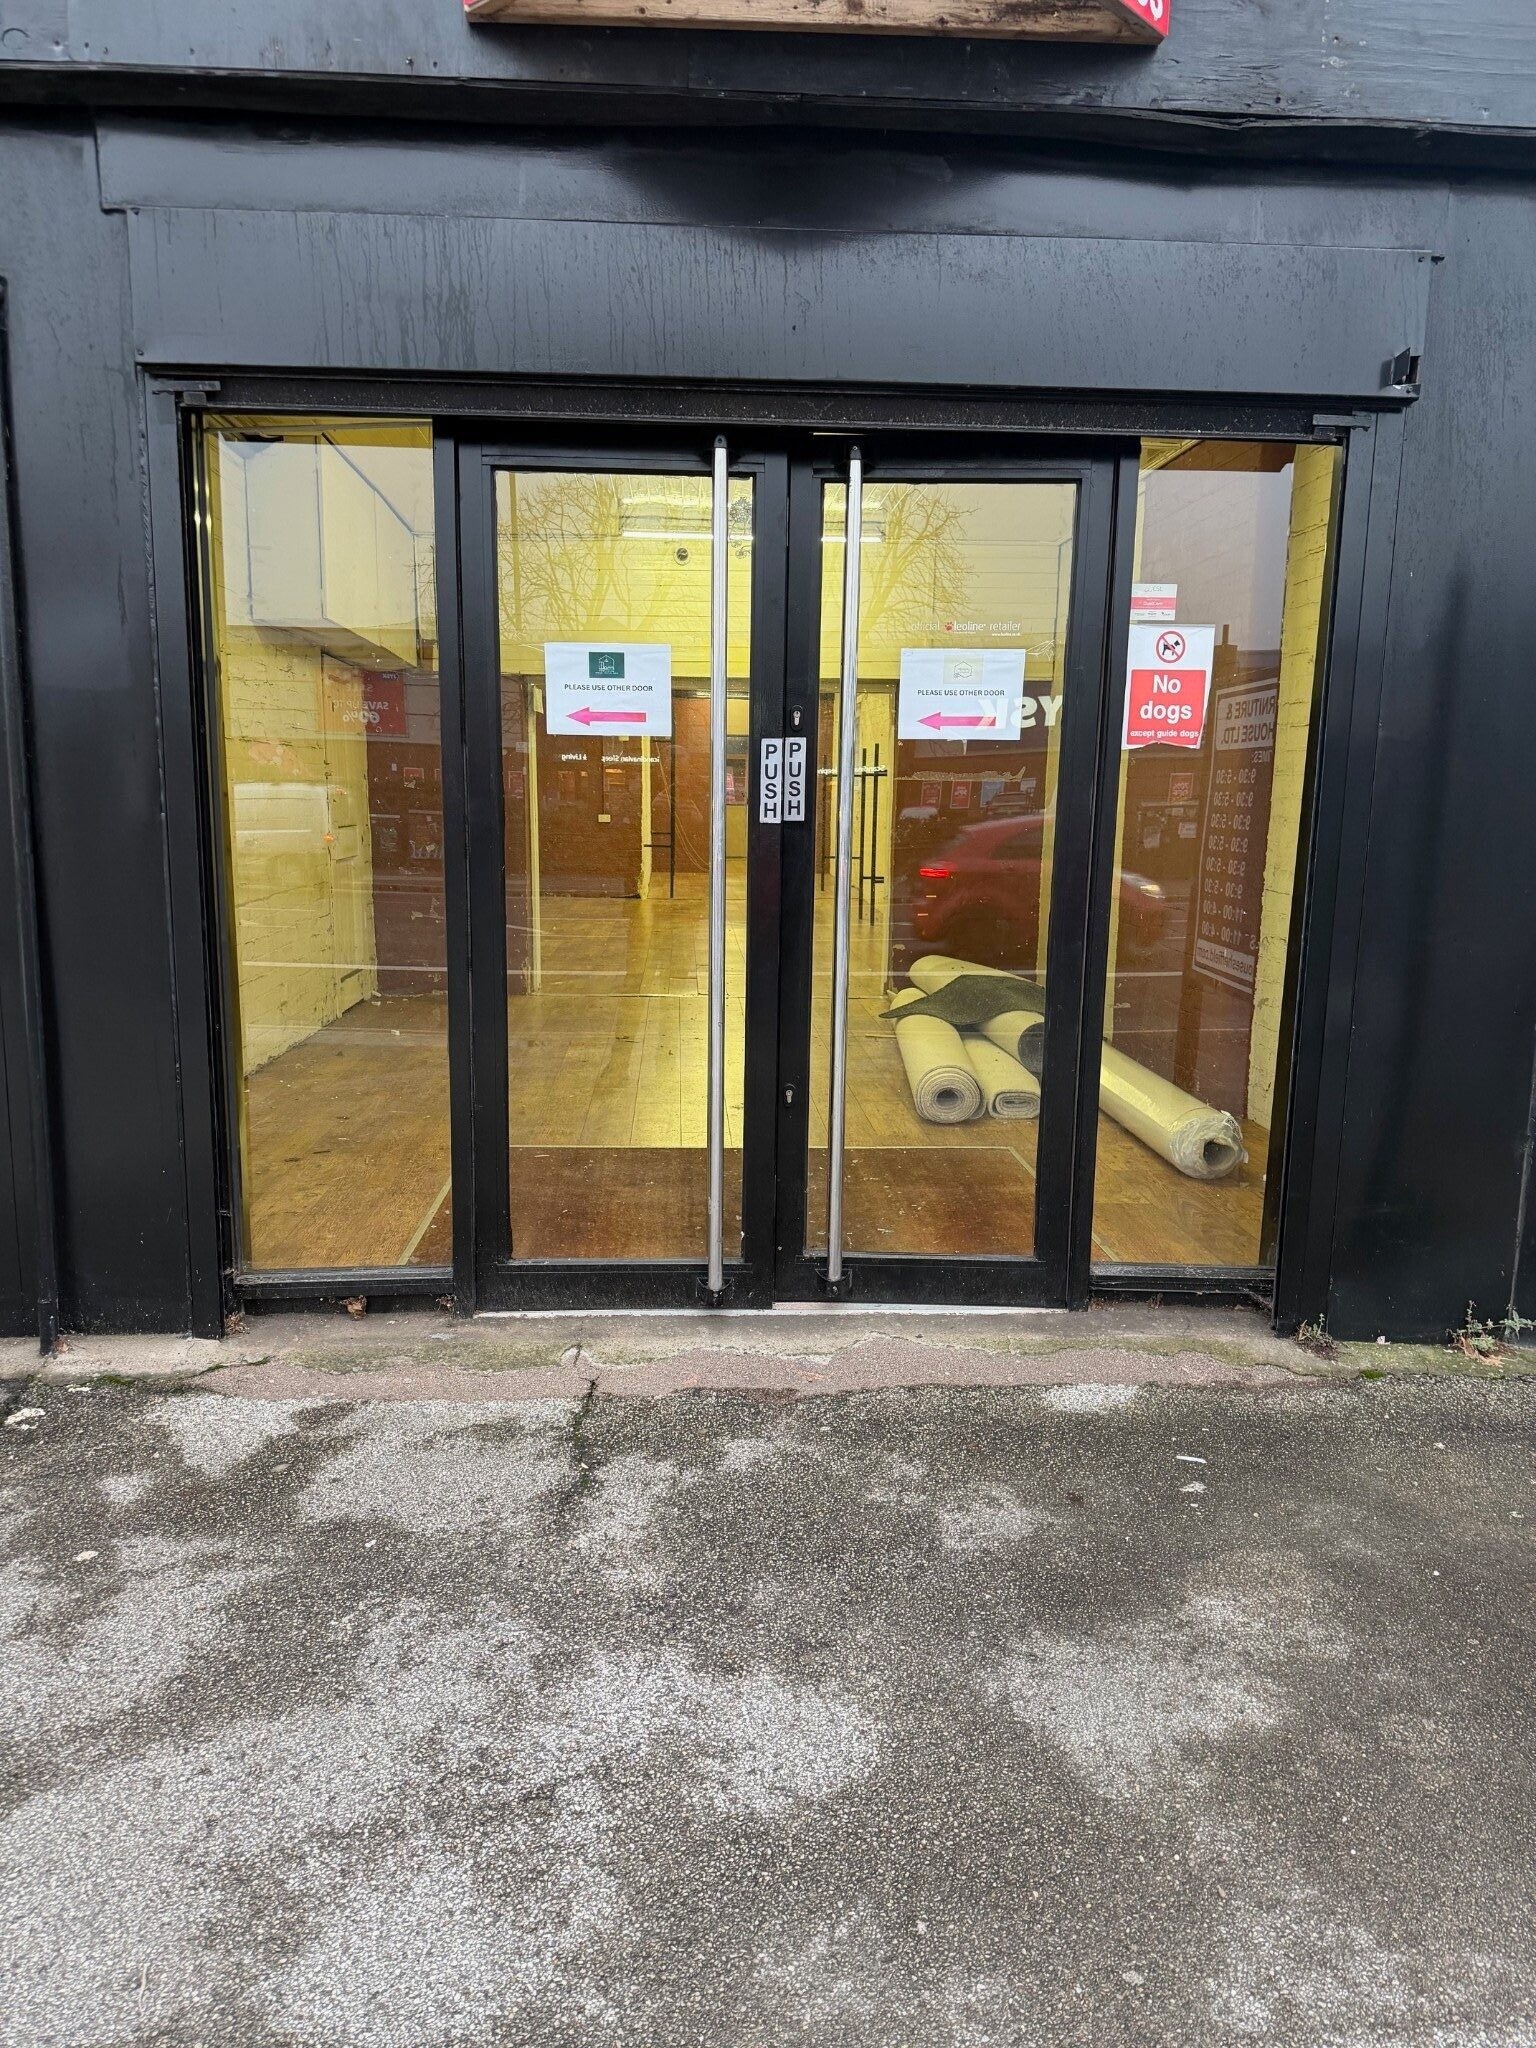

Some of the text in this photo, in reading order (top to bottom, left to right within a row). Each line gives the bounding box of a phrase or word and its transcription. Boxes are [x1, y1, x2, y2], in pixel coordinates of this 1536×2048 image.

[911, 621, 940, 631] official
[990, 621, 1021, 631] retailer
[1152, 674, 1182, 694] No
[1140, 701, 1193, 725] dogs
[1130, 729, 1200, 739] except guide dogs
[764, 744, 778, 818] PUSH
[788, 742, 802, 816] PUSH
